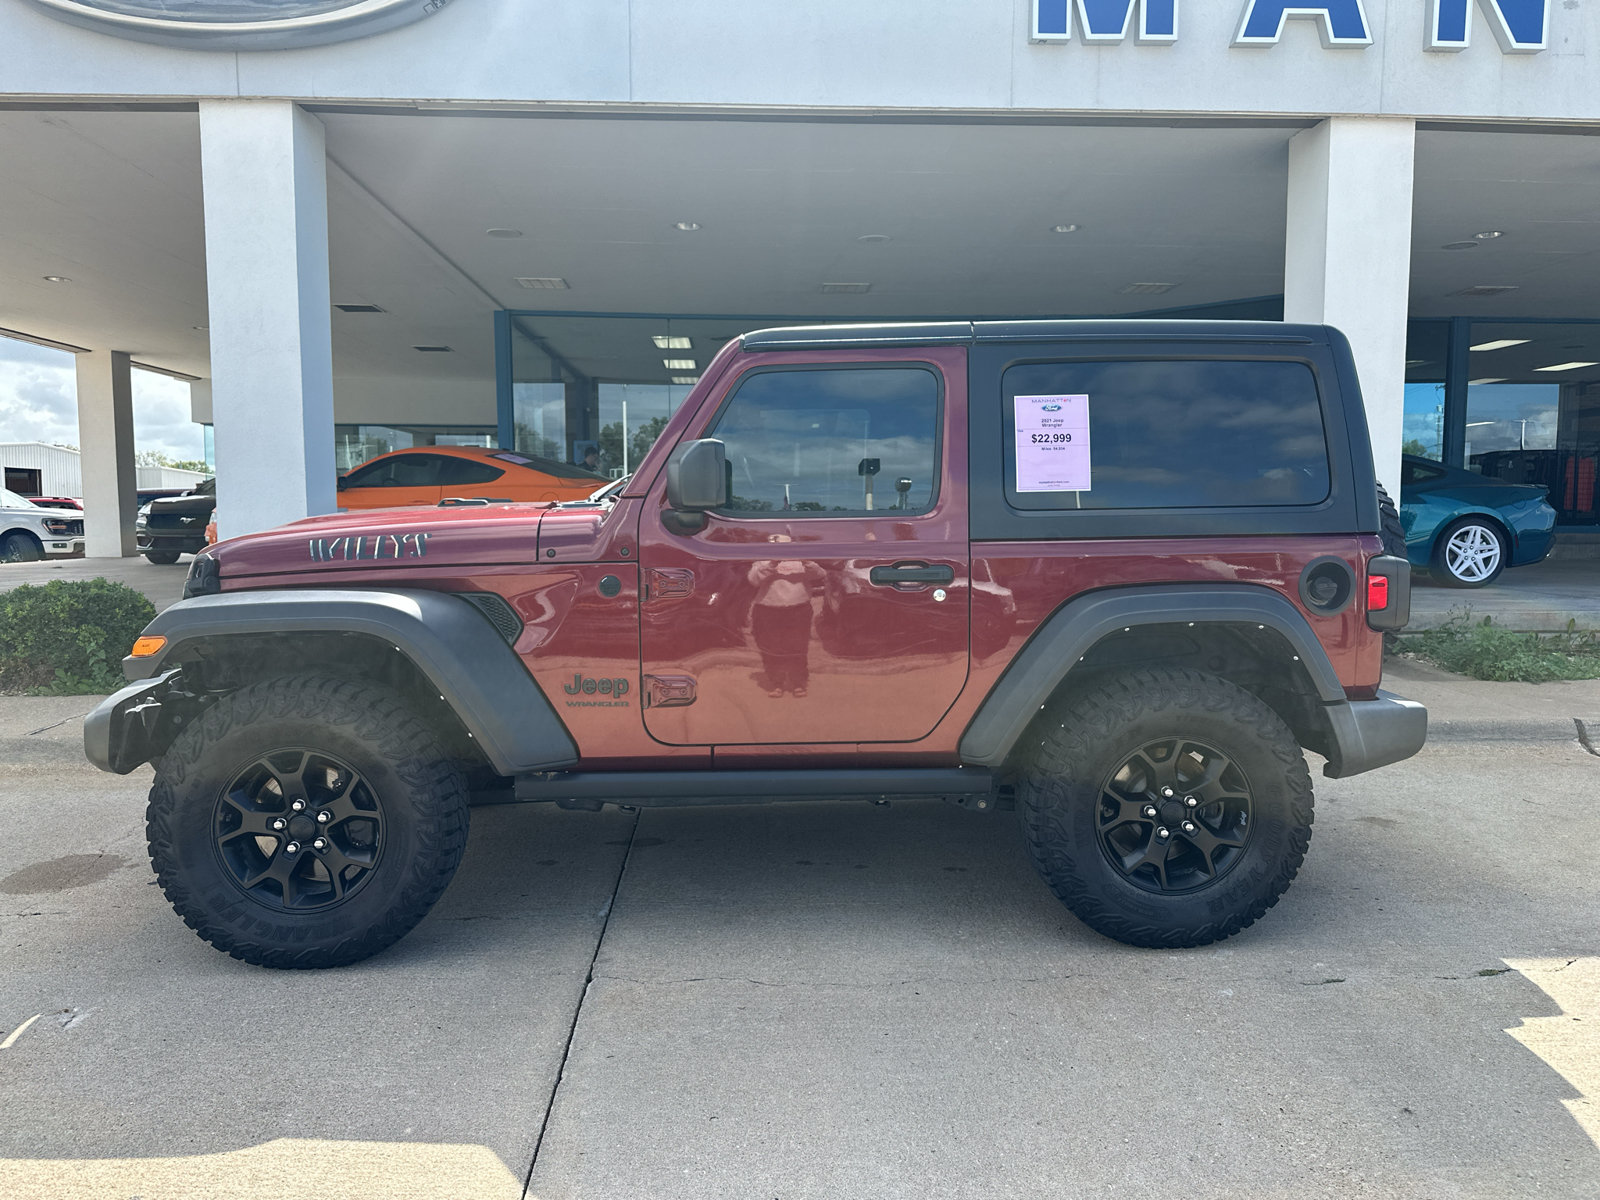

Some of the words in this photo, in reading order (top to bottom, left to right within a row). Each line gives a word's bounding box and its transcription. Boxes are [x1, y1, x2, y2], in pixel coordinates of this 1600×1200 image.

[1031, 433, 1072, 444] $22,999
[309, 533, 432, 562] WILLYS
[564, 673, 629, 699] Jeep
